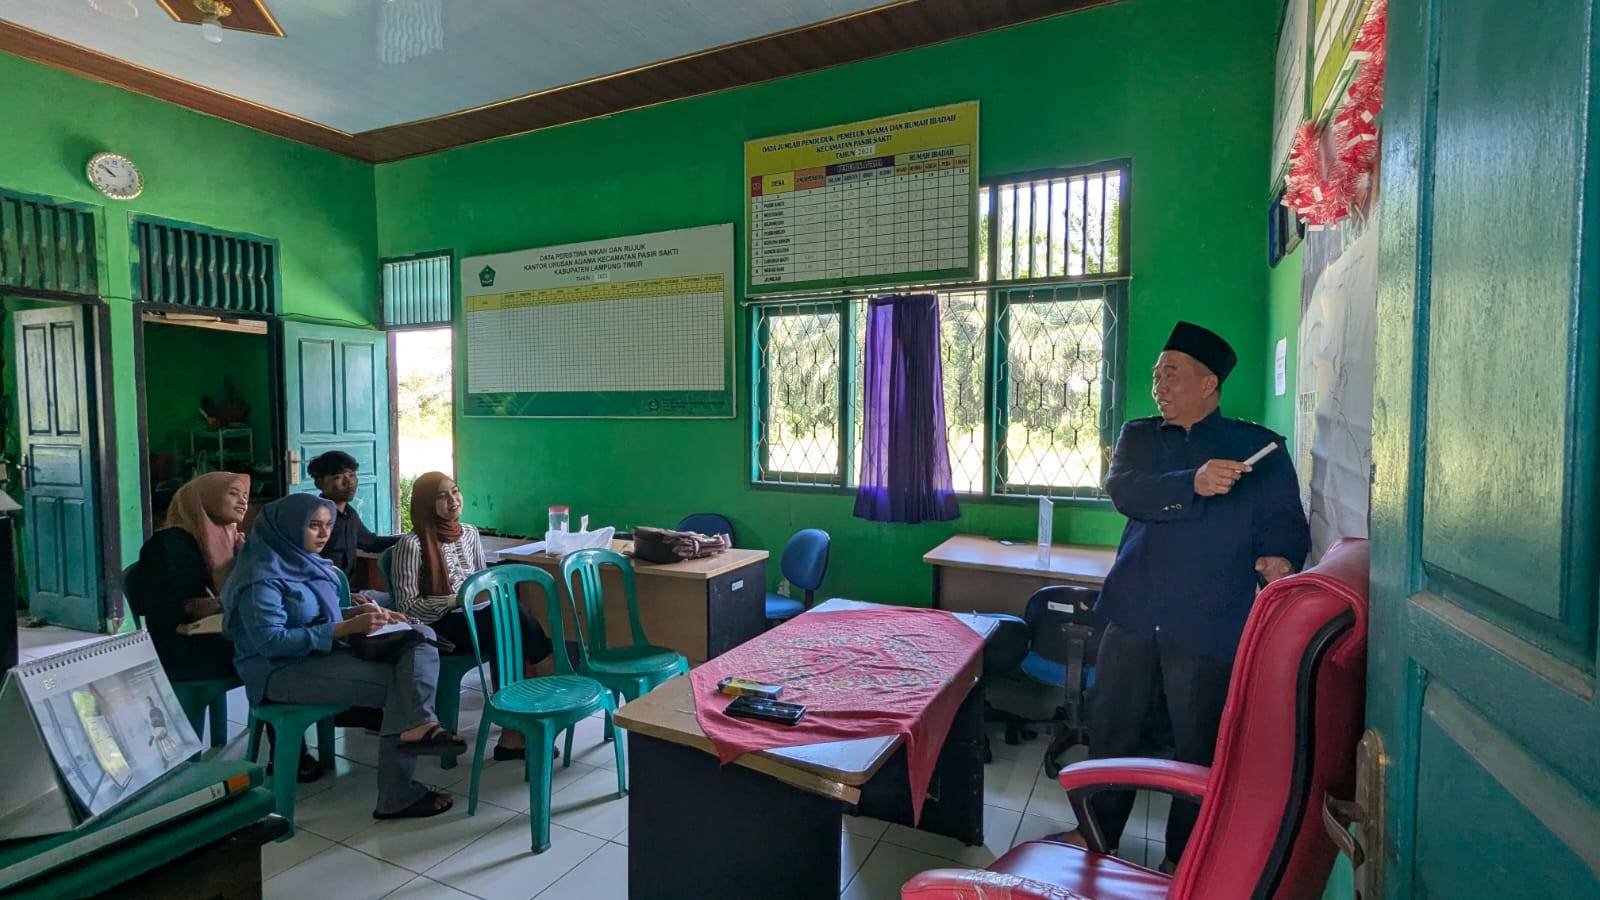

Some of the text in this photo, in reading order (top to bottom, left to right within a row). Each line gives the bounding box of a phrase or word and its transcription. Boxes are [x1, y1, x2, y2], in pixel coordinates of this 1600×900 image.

[762, 144, 777, 153] DATA
[777, 140, 801, 151] JUMLAH
[837, 129, 865, 141] PEMELUK
[866, 125, 888, 136] AGAMA
[889, 123, 903, 132] DAN
[904, 118, 929, 129] RUMAH
[929, 114, 956, 125] IBADAH
[816, 134, 892, 153] KECAMATAN PASIR SAKTI
[836, 150, 855, 160] TAHUN
[908, 148, 954, 161] RUMAH IBADAH
[523, 248, 679, 271] KANTOR URUSAN AGAMA KECAMATAN PASIR SAKTI
[540, 243, 646, 262] DATA PERISTIWA NIKAH DAN RUJUK
[554, 260, 643, 275] KABUPATEN LAMPUNG TIMUR
